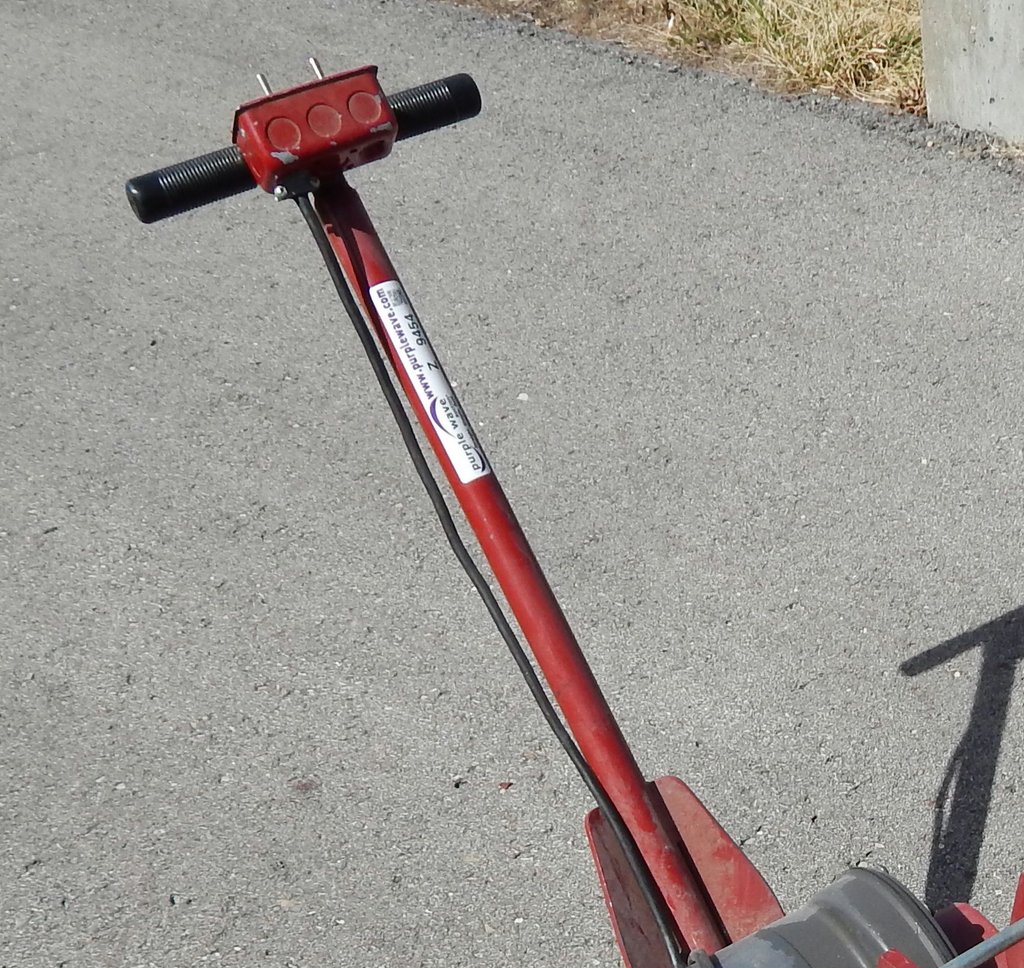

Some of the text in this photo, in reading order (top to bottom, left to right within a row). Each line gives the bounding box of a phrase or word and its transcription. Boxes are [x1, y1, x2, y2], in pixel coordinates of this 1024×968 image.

[376, 288, 434, 400] www.purplewave.com
[404, 313, 440, 371] Z 9454
[440, 397, 459, 430] wave
[456, 432, 481, 471] purple
